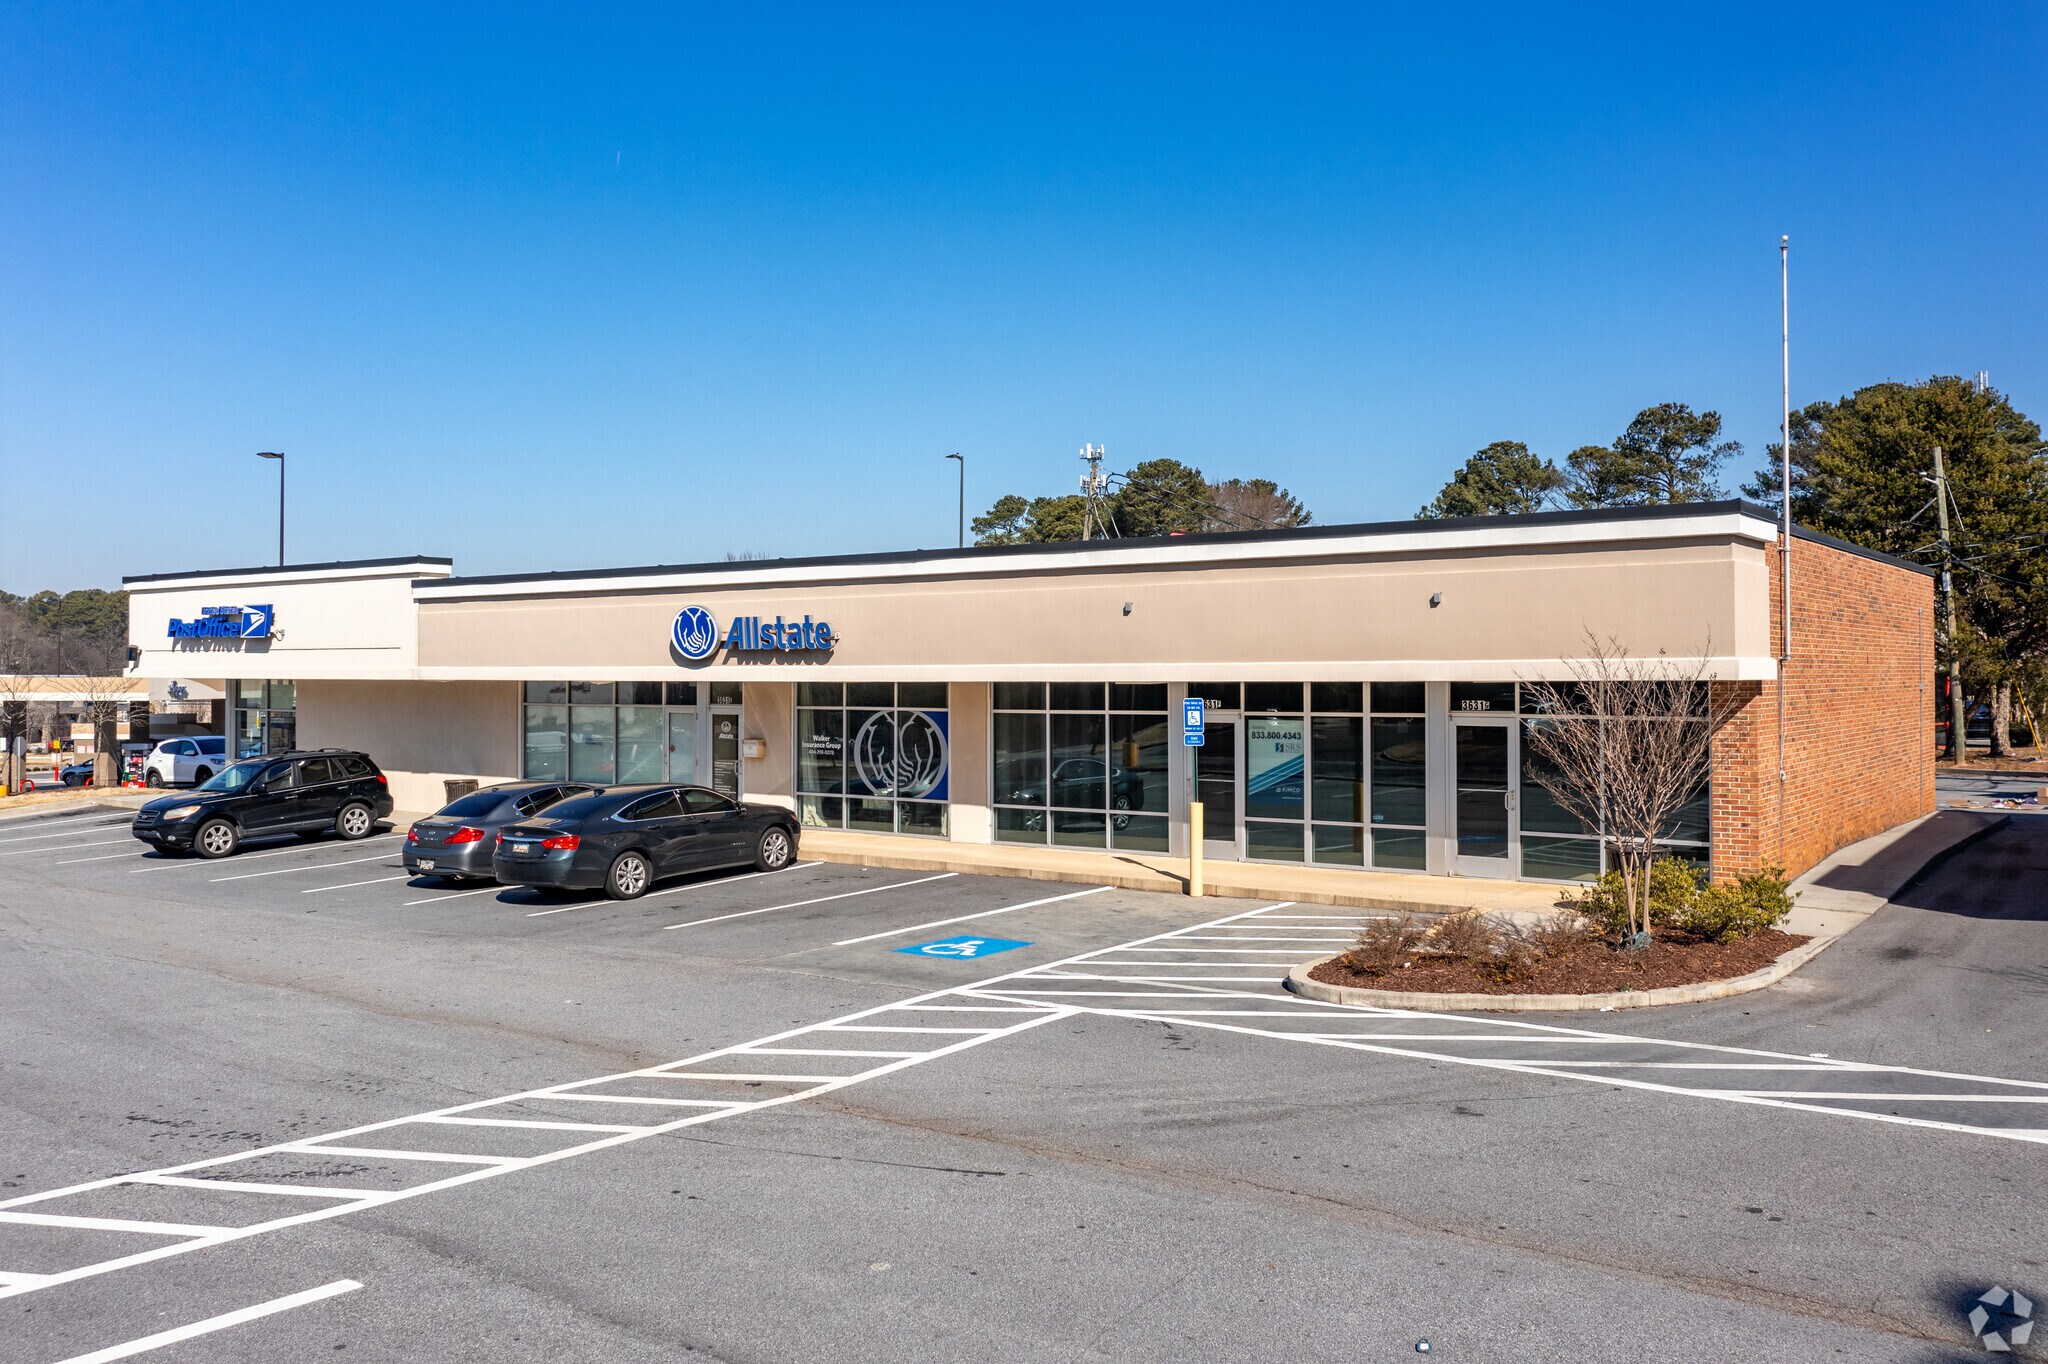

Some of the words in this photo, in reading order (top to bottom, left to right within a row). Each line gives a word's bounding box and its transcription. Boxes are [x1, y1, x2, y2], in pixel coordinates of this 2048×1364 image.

[723, 615, 832, 651] Allstate
[1461, 700, 1490, 711] 3631G
[812, 734, 831, 742] Walker
[1251, 731, 1302, 740] 833.800.4343
[801, 741, 826, 749] Insurance
[825, 741, 842, 750] Group
[1285, 743, 1301, 751] SRS
